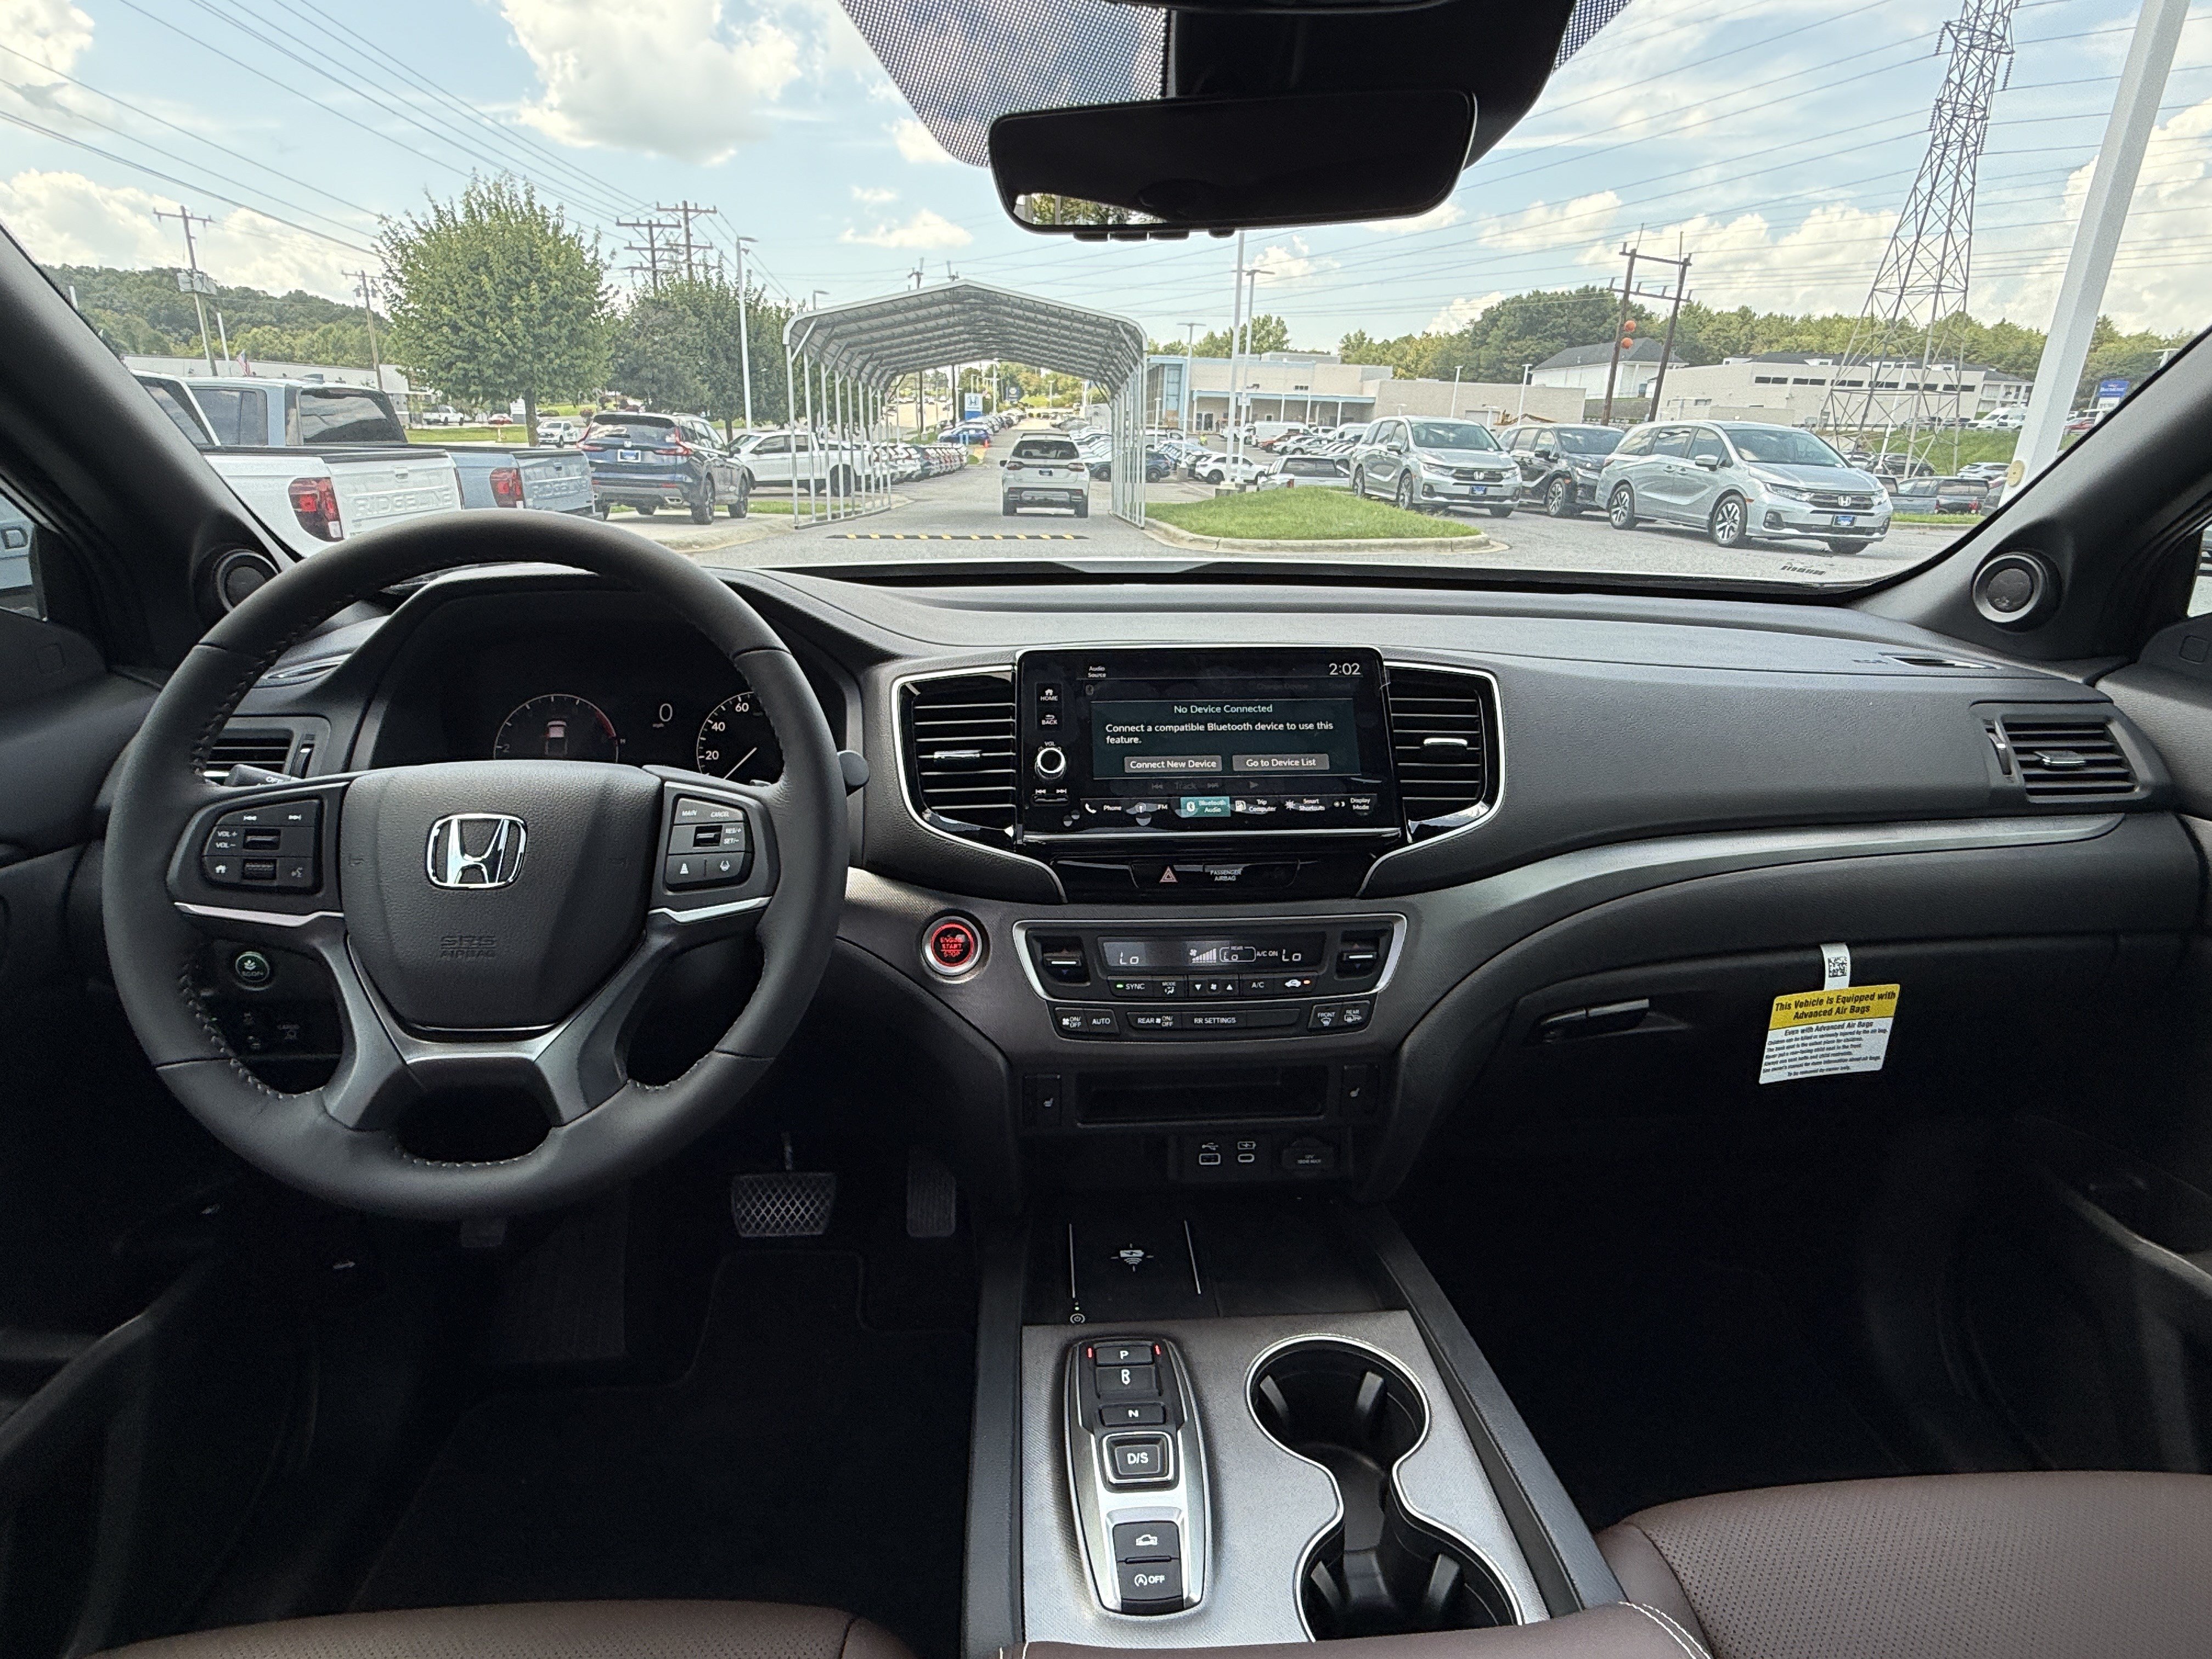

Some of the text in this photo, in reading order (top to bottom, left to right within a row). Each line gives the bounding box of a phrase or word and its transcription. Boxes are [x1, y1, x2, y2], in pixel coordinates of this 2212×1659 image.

[1329, 663, 1362, 675] 2:02
[659, 703, 673, 722] 0
[735, 703, 749, 712] 60
[1190, 705, 1221, 713] Device
[1223, 705, 1273, 713] Connected
[711, 721, 725, 731] 40
[1105, 724, 1145, 732] Connect
[1154, 723, 1205, 733] compatible
[1207, 722, 1252, 731] Bluetooth
[1255, 722, 1284, 731] device
[1317, 721, 1333, 730] this
[1105, 736, 1142, 744] feature.
[705, 750, 719, 760] 20
[1130, 759, 1217, 769] Connect New Device
[1271, 758, 1299, 766] Device
[1301, 757, 1316, 766] List
[1119, 951, 1139, 964] Lo
[1282, 949, 1301, 962] Lo
[1775, 1002, 1792, 1011] This
[1836, 992, 1876, 1005] Equipped
[1877, 991, 1896, 1000] with
[1793, 1005, 1871, 1020] Advanced Air Bags
[1120, 1350, 1129, 1359] P
[1128, 1409, 1139, 1418] N
[1127, 1452, 1149, 1465] D/S
[1148, 1575, 1165, 1584] OFF
